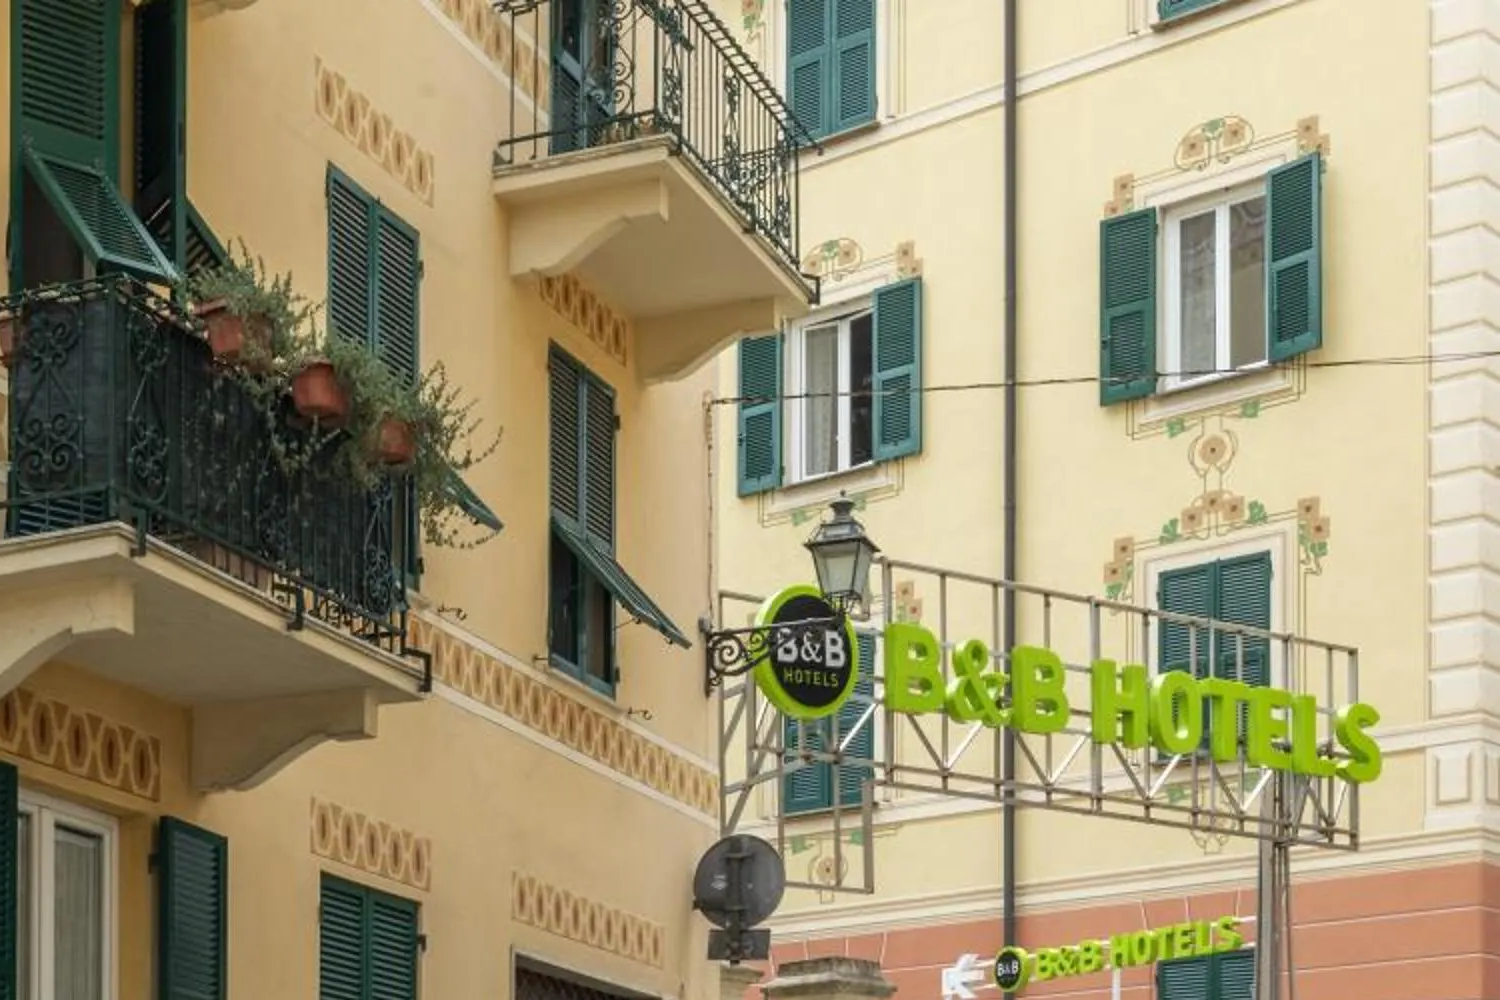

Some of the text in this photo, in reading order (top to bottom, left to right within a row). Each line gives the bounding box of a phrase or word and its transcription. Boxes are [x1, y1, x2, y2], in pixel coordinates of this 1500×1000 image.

[776, 626, 846, 668] B&B
[783, 668, 839, 688] HOTELS
[884, 623, 1384, 784] B&B HOTELS
[997, 960, 1019, 977] B&B
[1035, 915, 1244, 981] B&B HOTELS
